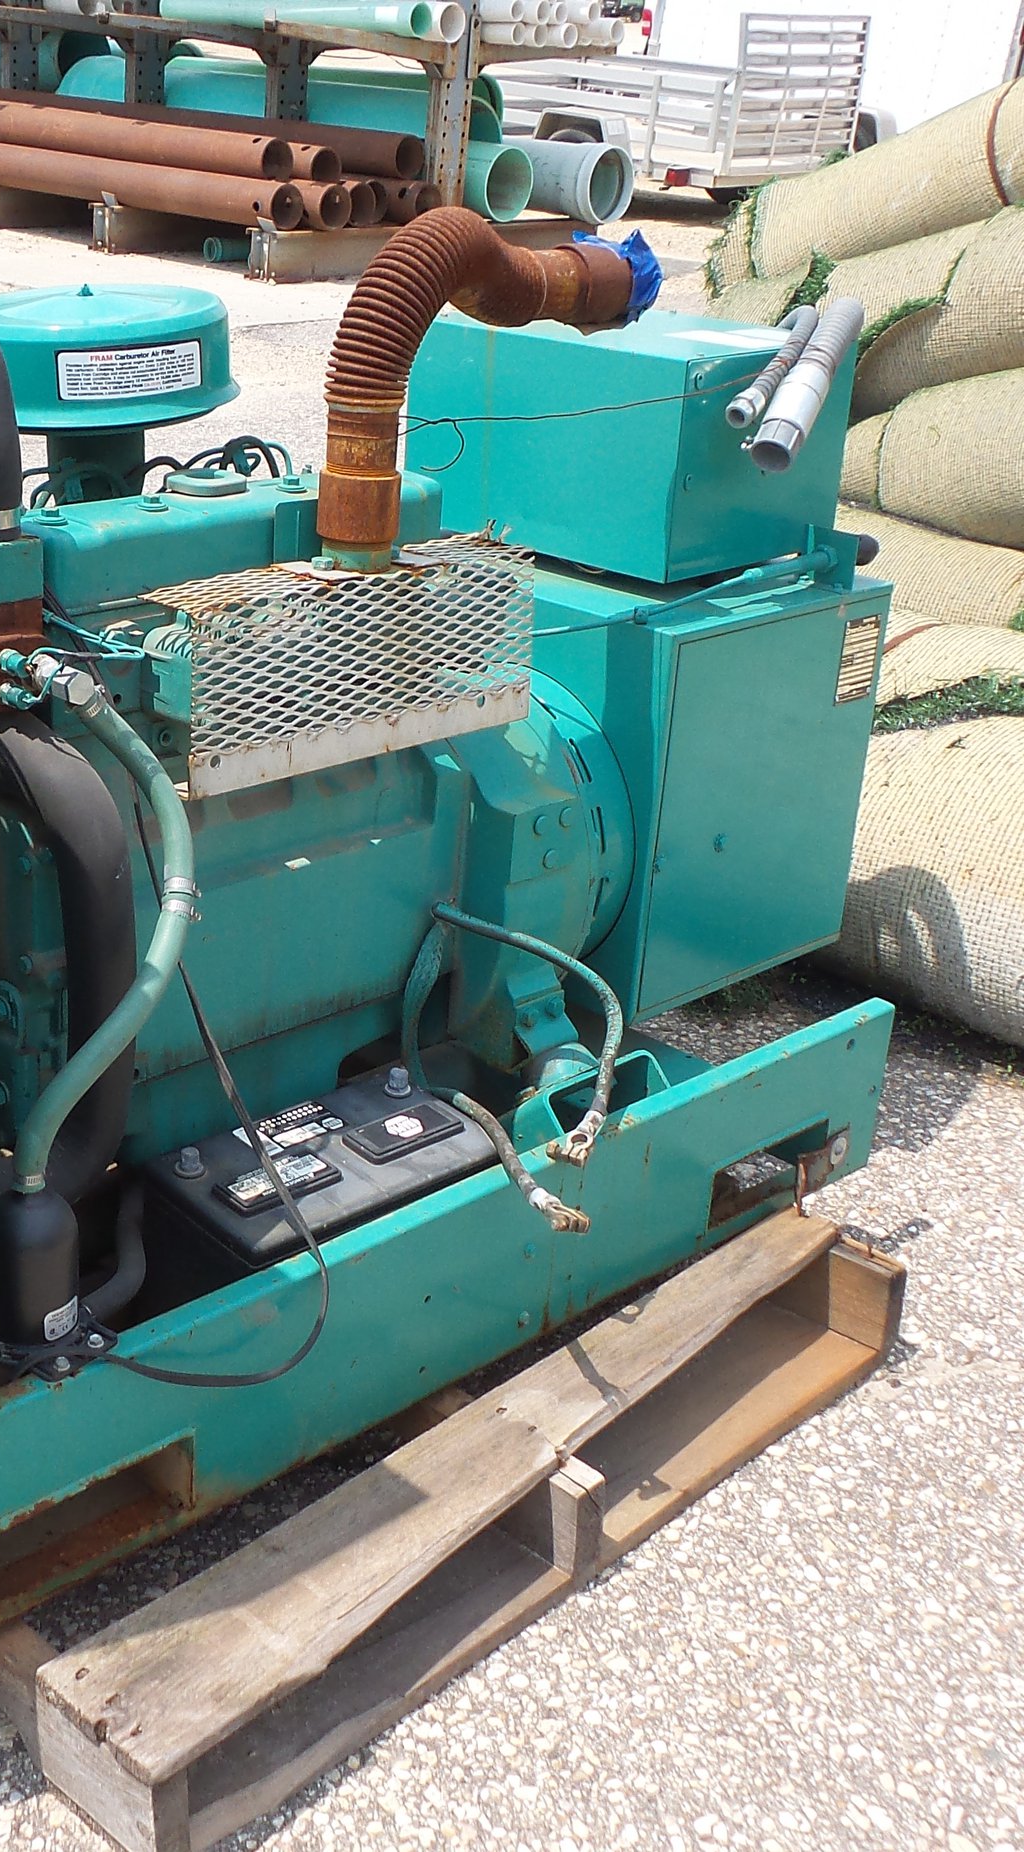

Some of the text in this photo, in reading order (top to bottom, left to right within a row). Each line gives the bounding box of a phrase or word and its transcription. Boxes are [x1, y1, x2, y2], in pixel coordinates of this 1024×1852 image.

[90, 354, 113, 362] FRAM
[114, 351, 149, 361] Carburetor
[150, 349, 160, 357] Air
[161, 348, 176, 356] Filter
